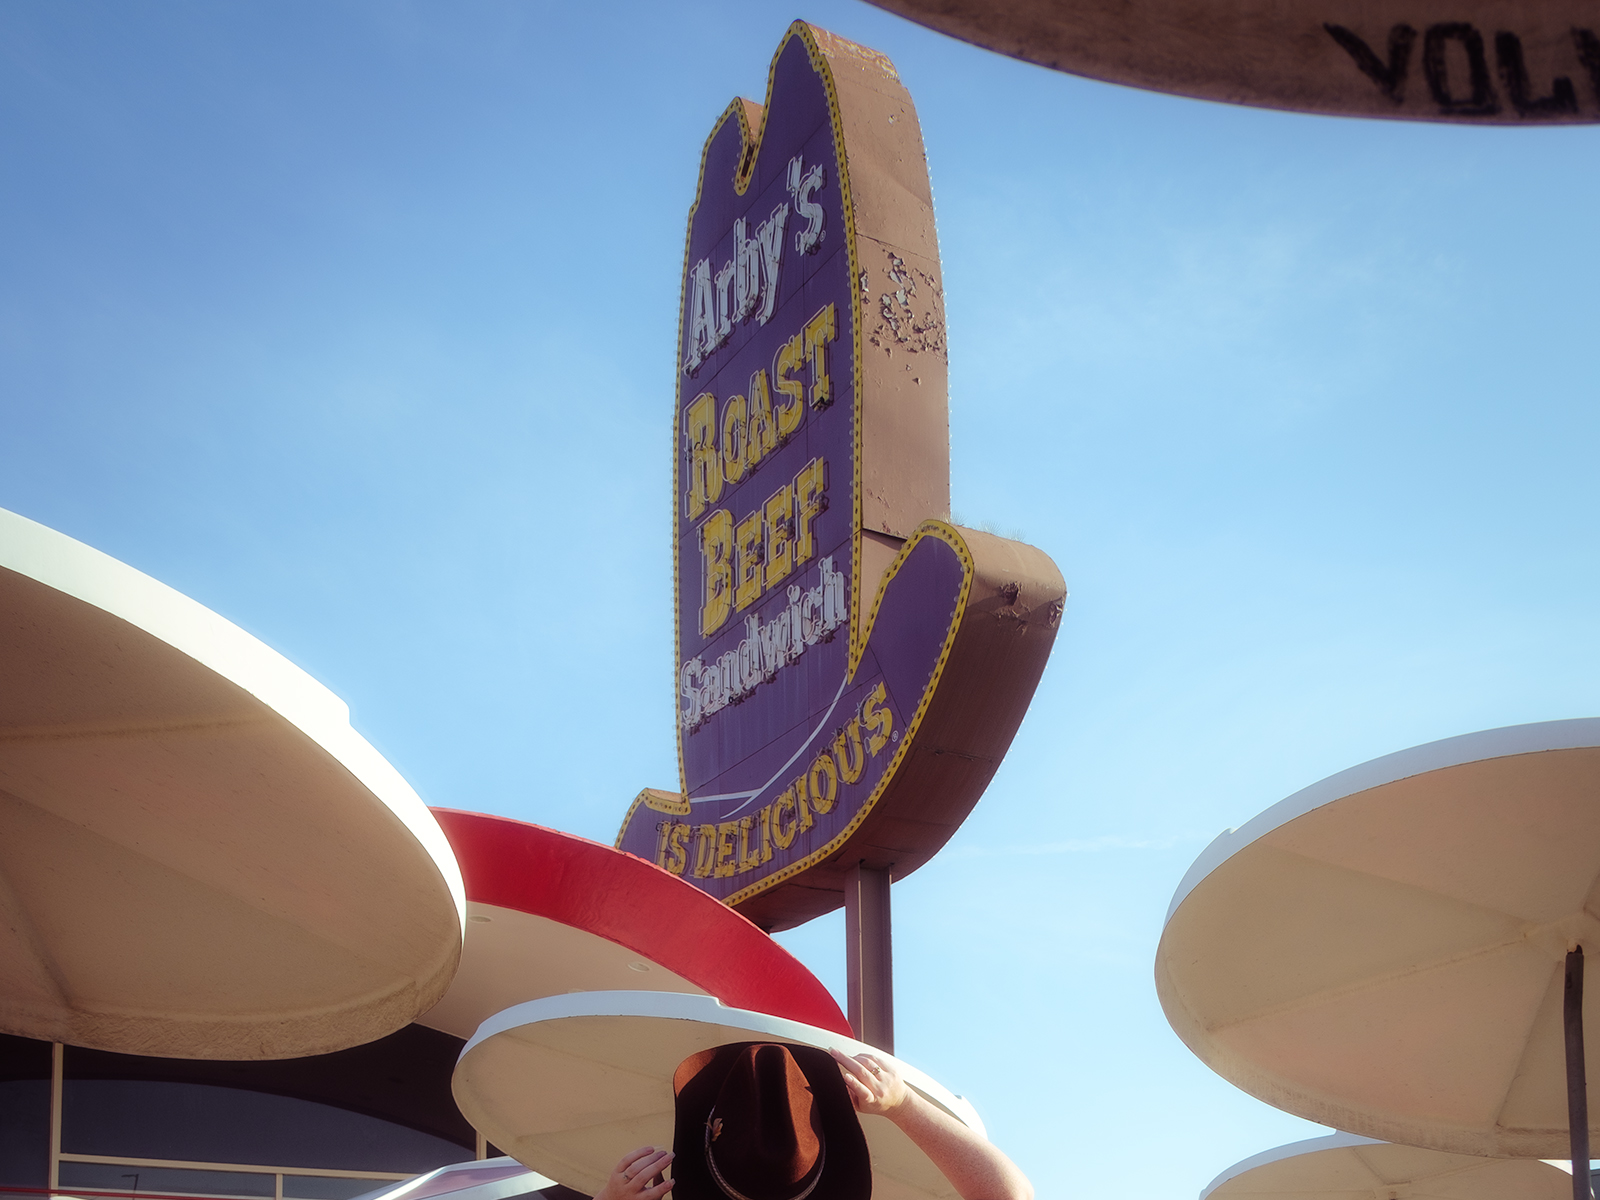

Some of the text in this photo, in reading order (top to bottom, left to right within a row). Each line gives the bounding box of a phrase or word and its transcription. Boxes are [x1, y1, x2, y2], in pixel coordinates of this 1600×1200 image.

[683, 155, 823, 378] Arby's
[683, 302, 837, 522] ROAST
[681, 555, 848, 732] Sandwich
[698, 456, 825, 639] BEEF
[655, 681, 893, 879] IS DELICIOUS
